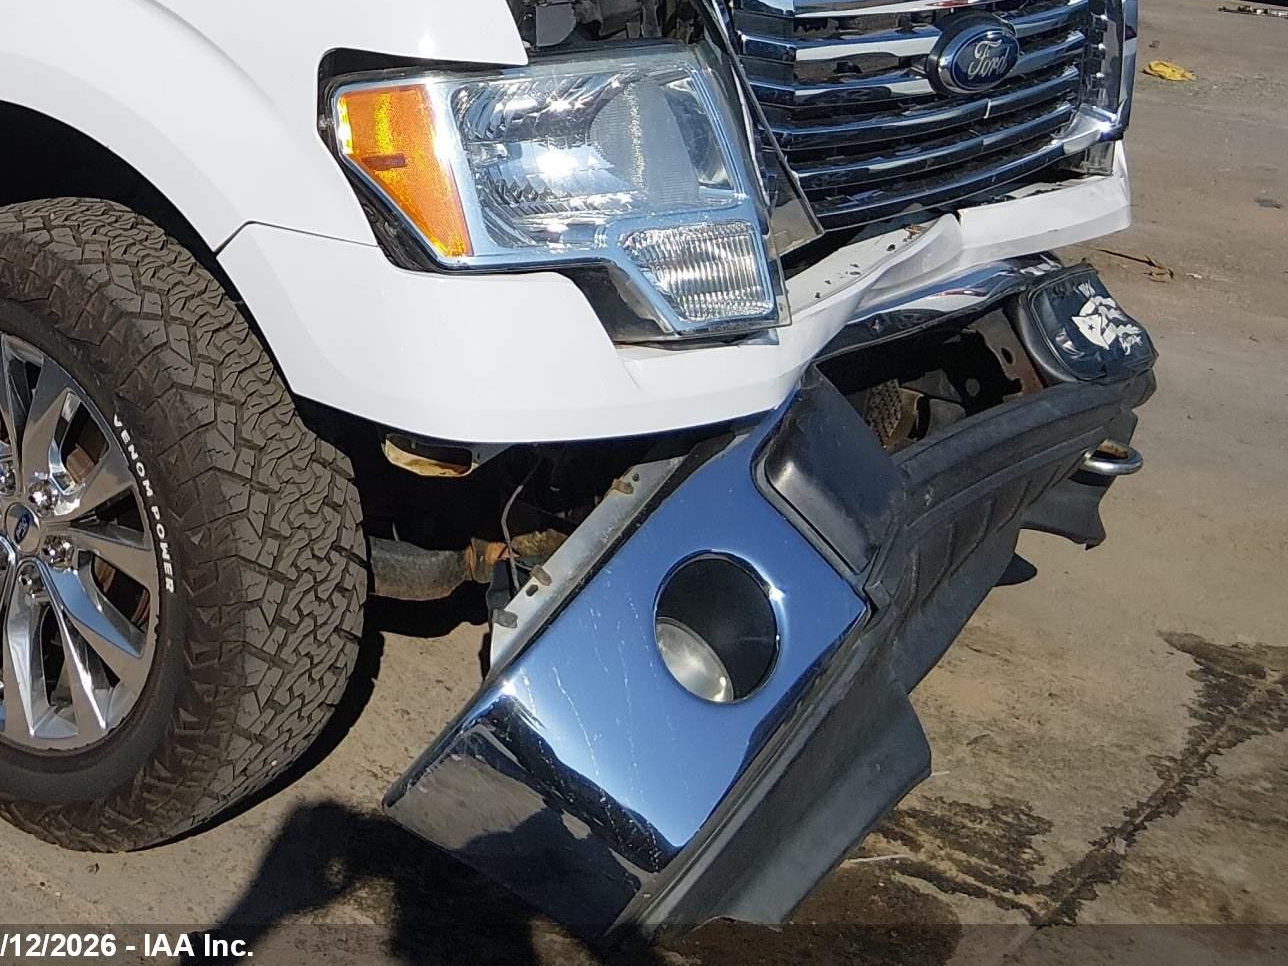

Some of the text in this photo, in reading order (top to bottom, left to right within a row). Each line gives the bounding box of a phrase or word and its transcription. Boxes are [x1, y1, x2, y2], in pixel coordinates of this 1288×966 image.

[967, 39, 1010, 80] Ford
[113, 413, 174, 594] VENOM POWER
